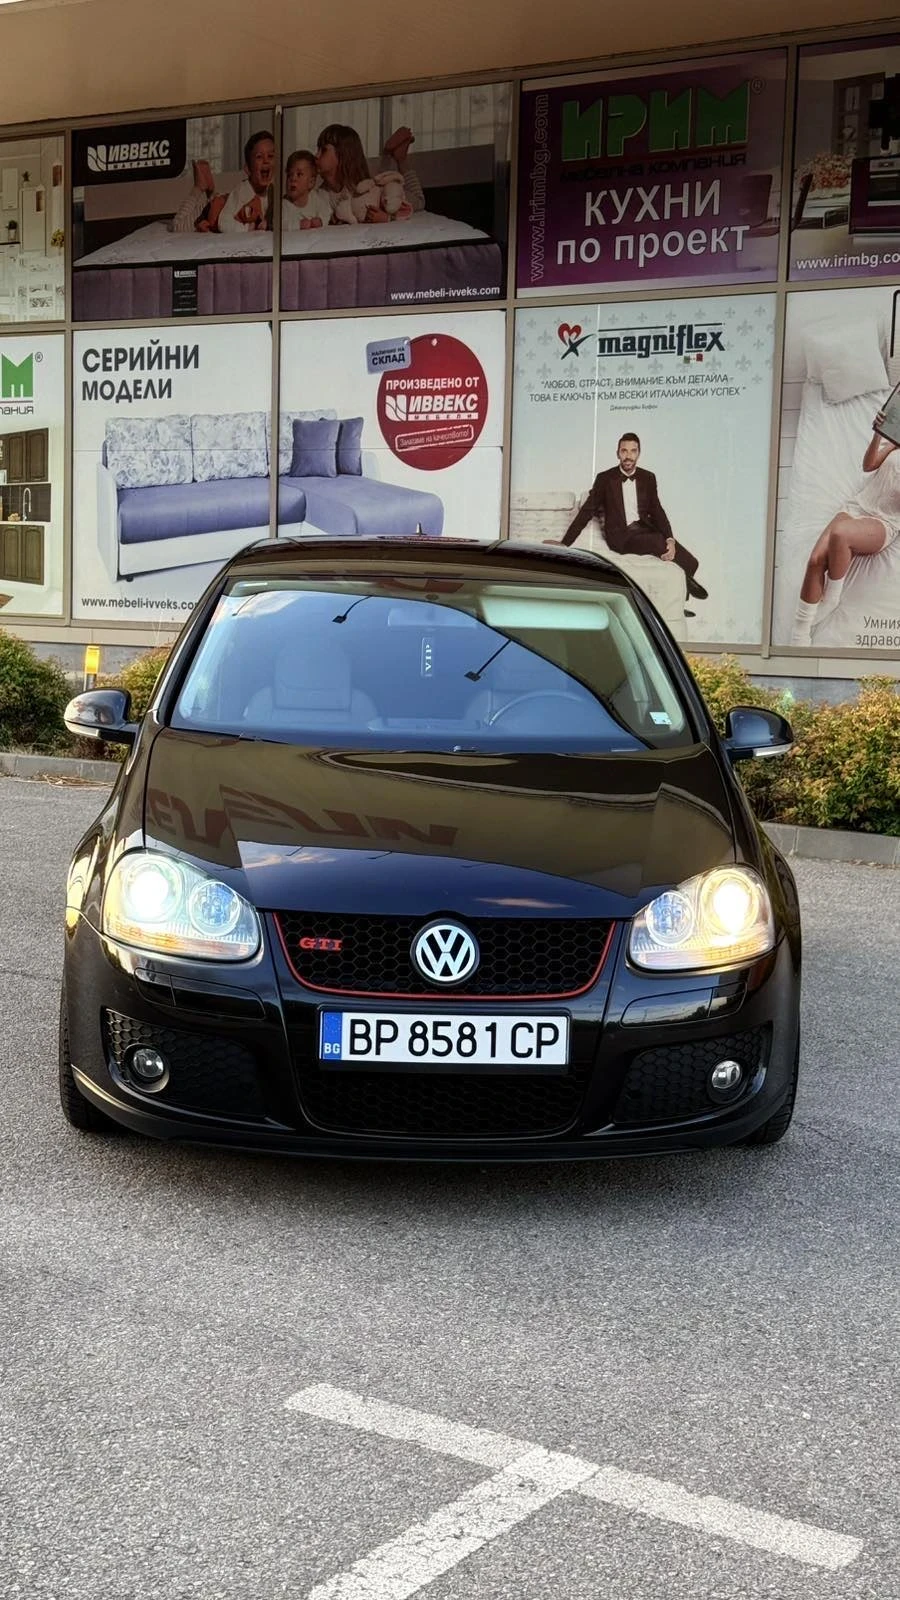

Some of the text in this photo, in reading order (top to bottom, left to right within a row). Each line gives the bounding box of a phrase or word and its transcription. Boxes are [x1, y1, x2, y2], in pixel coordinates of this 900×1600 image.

[561, 80, 750, 162] ИРИМ
[108, 140, 170, 162] ИВВЕКС
[529, 94, 550, 282] www.irimbg.com
[584, 178, 721, 227] КУХНИ
[556, 224, 750, 268] по проект
[390, 286, 500, 300] www.mebeli-ivveks.com
[598, 324, 726, 359] magniflex
[82, 339, 199, 373] СЕРИЙНИ
[372, 353, 405, 366] СКЛАД
[82, 378, 172, 404] МОДЕЛИ
[385, 376, 480, 391] ПРОИЗВЕДЕНО ОТ
[579, 378, 613, 389] СТРАСТ,
[614, 376, 664, 387] ВНИМАНИЕ
[665, 375, 686, 385] КЪМ
[687, 373, 729, 385] ДЕТАЙЛА
[408, 393, 479, 412] ИВВЕКС
[529, 393, 551, 402] ТОВА
[552, 392, 559, 401] Е
[560, 391, 596, 401] КЛЮЧЪТ
[597, 390, 617, 400] КЪМ
[618, 389, 648, 399] ВСЕКИ
[649, 387, 709, 398] ИТАЛИАНСКИ
[710, 386, 740, 397] УСПЕХ
[81, 598, 198, 610] www.mebeli-ivveks.co
[300, 937, 342, 950] GTI
[323, 1042, 340, 1054] BG
[350, 1019, 559, 1058] BP 8581 CP
